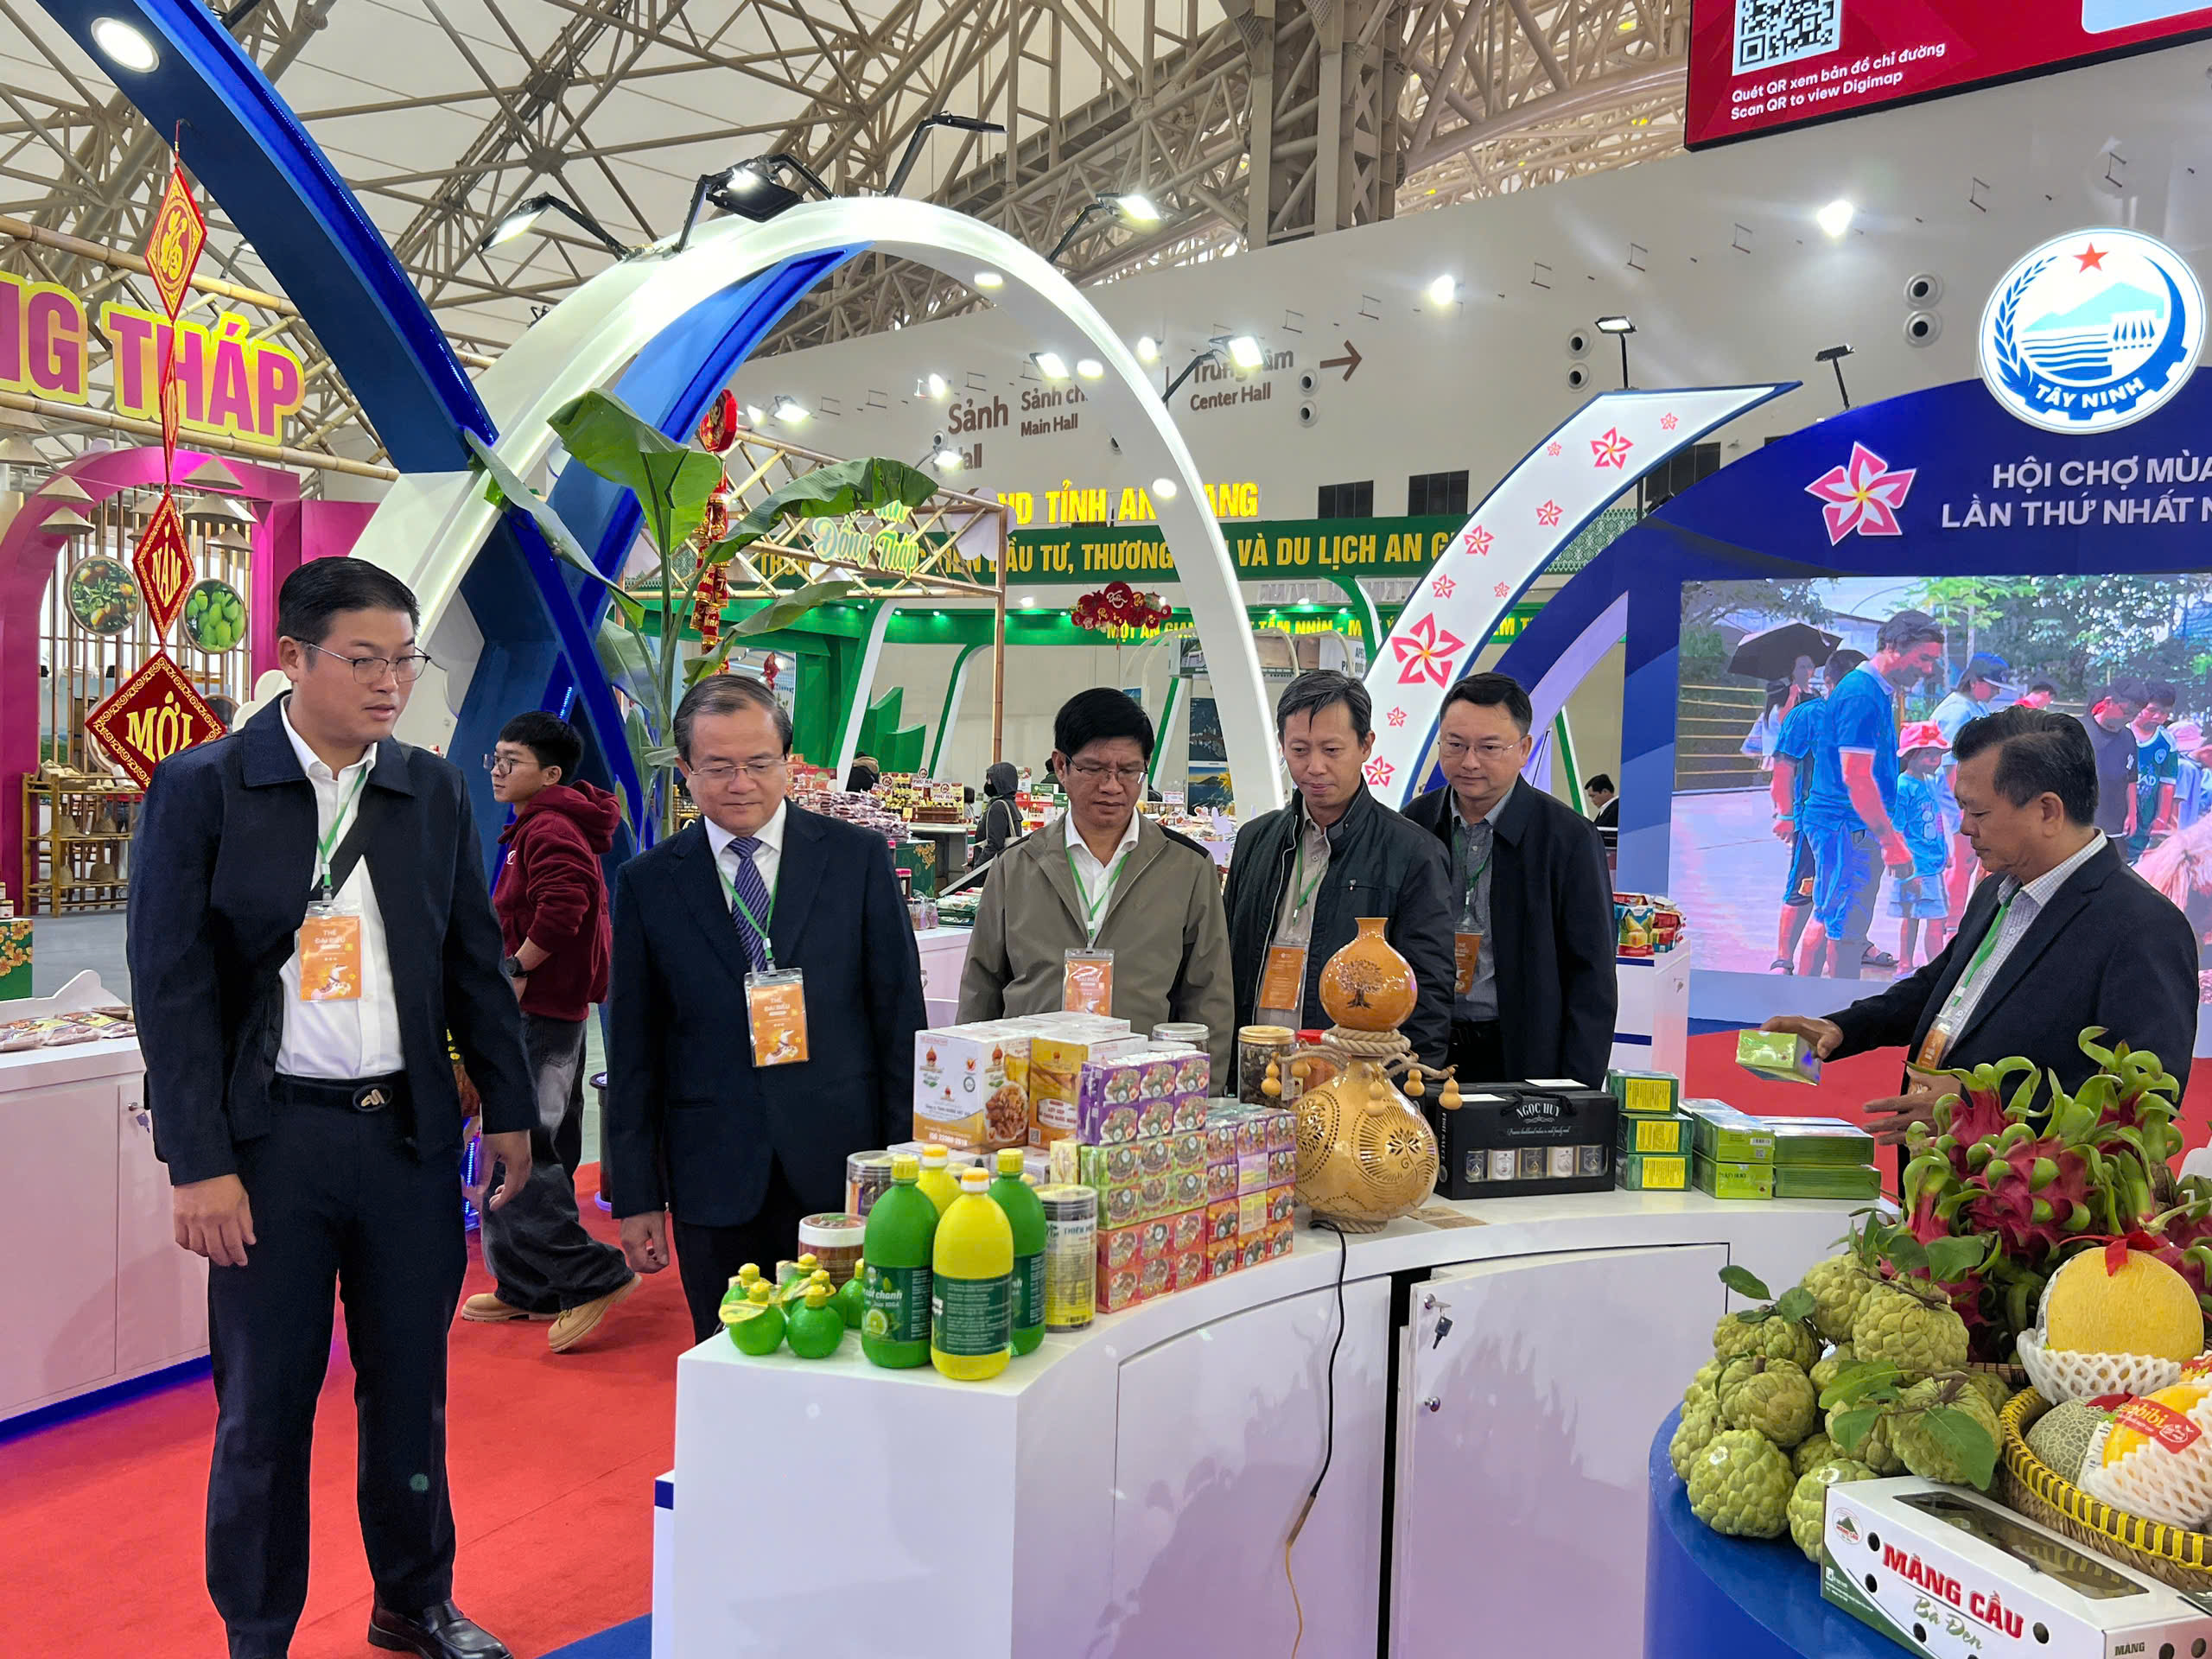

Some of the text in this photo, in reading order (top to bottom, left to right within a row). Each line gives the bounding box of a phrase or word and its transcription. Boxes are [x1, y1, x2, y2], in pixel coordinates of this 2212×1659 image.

[1732, 42, 1946, 103] Quét QR xem bản đồ chỉ đường
[1731, 71, 1904, 120] Scan QR to view Digimap
[110, 311, 299, 437] THÁP
[2035, 377, 2145, 409] TÂY NINH
[948, 395, 1008, 435] Sảnh
[1021, 385, 1062, 411] Sảnh
[1190, 381, 1271, 411] Center Hall
[1020, 413, 1078, 437] Main Hall
[1993, 455, 2052, 494] HỘI
[2059, 454, 2139, 491] CHỢ
[1046, 479, 1108, 524] TỈNH
[1942, 493, 2012, 528] LẦN
[2021, 491, 2097, 527] THỨ
[2103, 488, 2195, 525] NHẤT
[813, 515, 871, 569] Đồng
[874, 531, 919, 579] Tháp
[1040, 541, 1074, 575] TƯ,
[1081, 538, 1175, 573] THƯƠNG
[1236, 532, 1268, 567] VÀ
[1276, 537, 1311, 566] DU
[1318, 534, 1376, 570] LỊCH
[1383, 532, 1422, 563] AN
[1294, 617, 1333, 635] NHÌN
[126, 691, 194, 764] MỚI
[1516, 1102, 1560, 1120] NGỌC HUY
[875, 1289, 903, 1300] chanh
[1913, 1593, 1983, 1650] Bà Đen
[1969, 1590, 2024, 1639] CẦU
